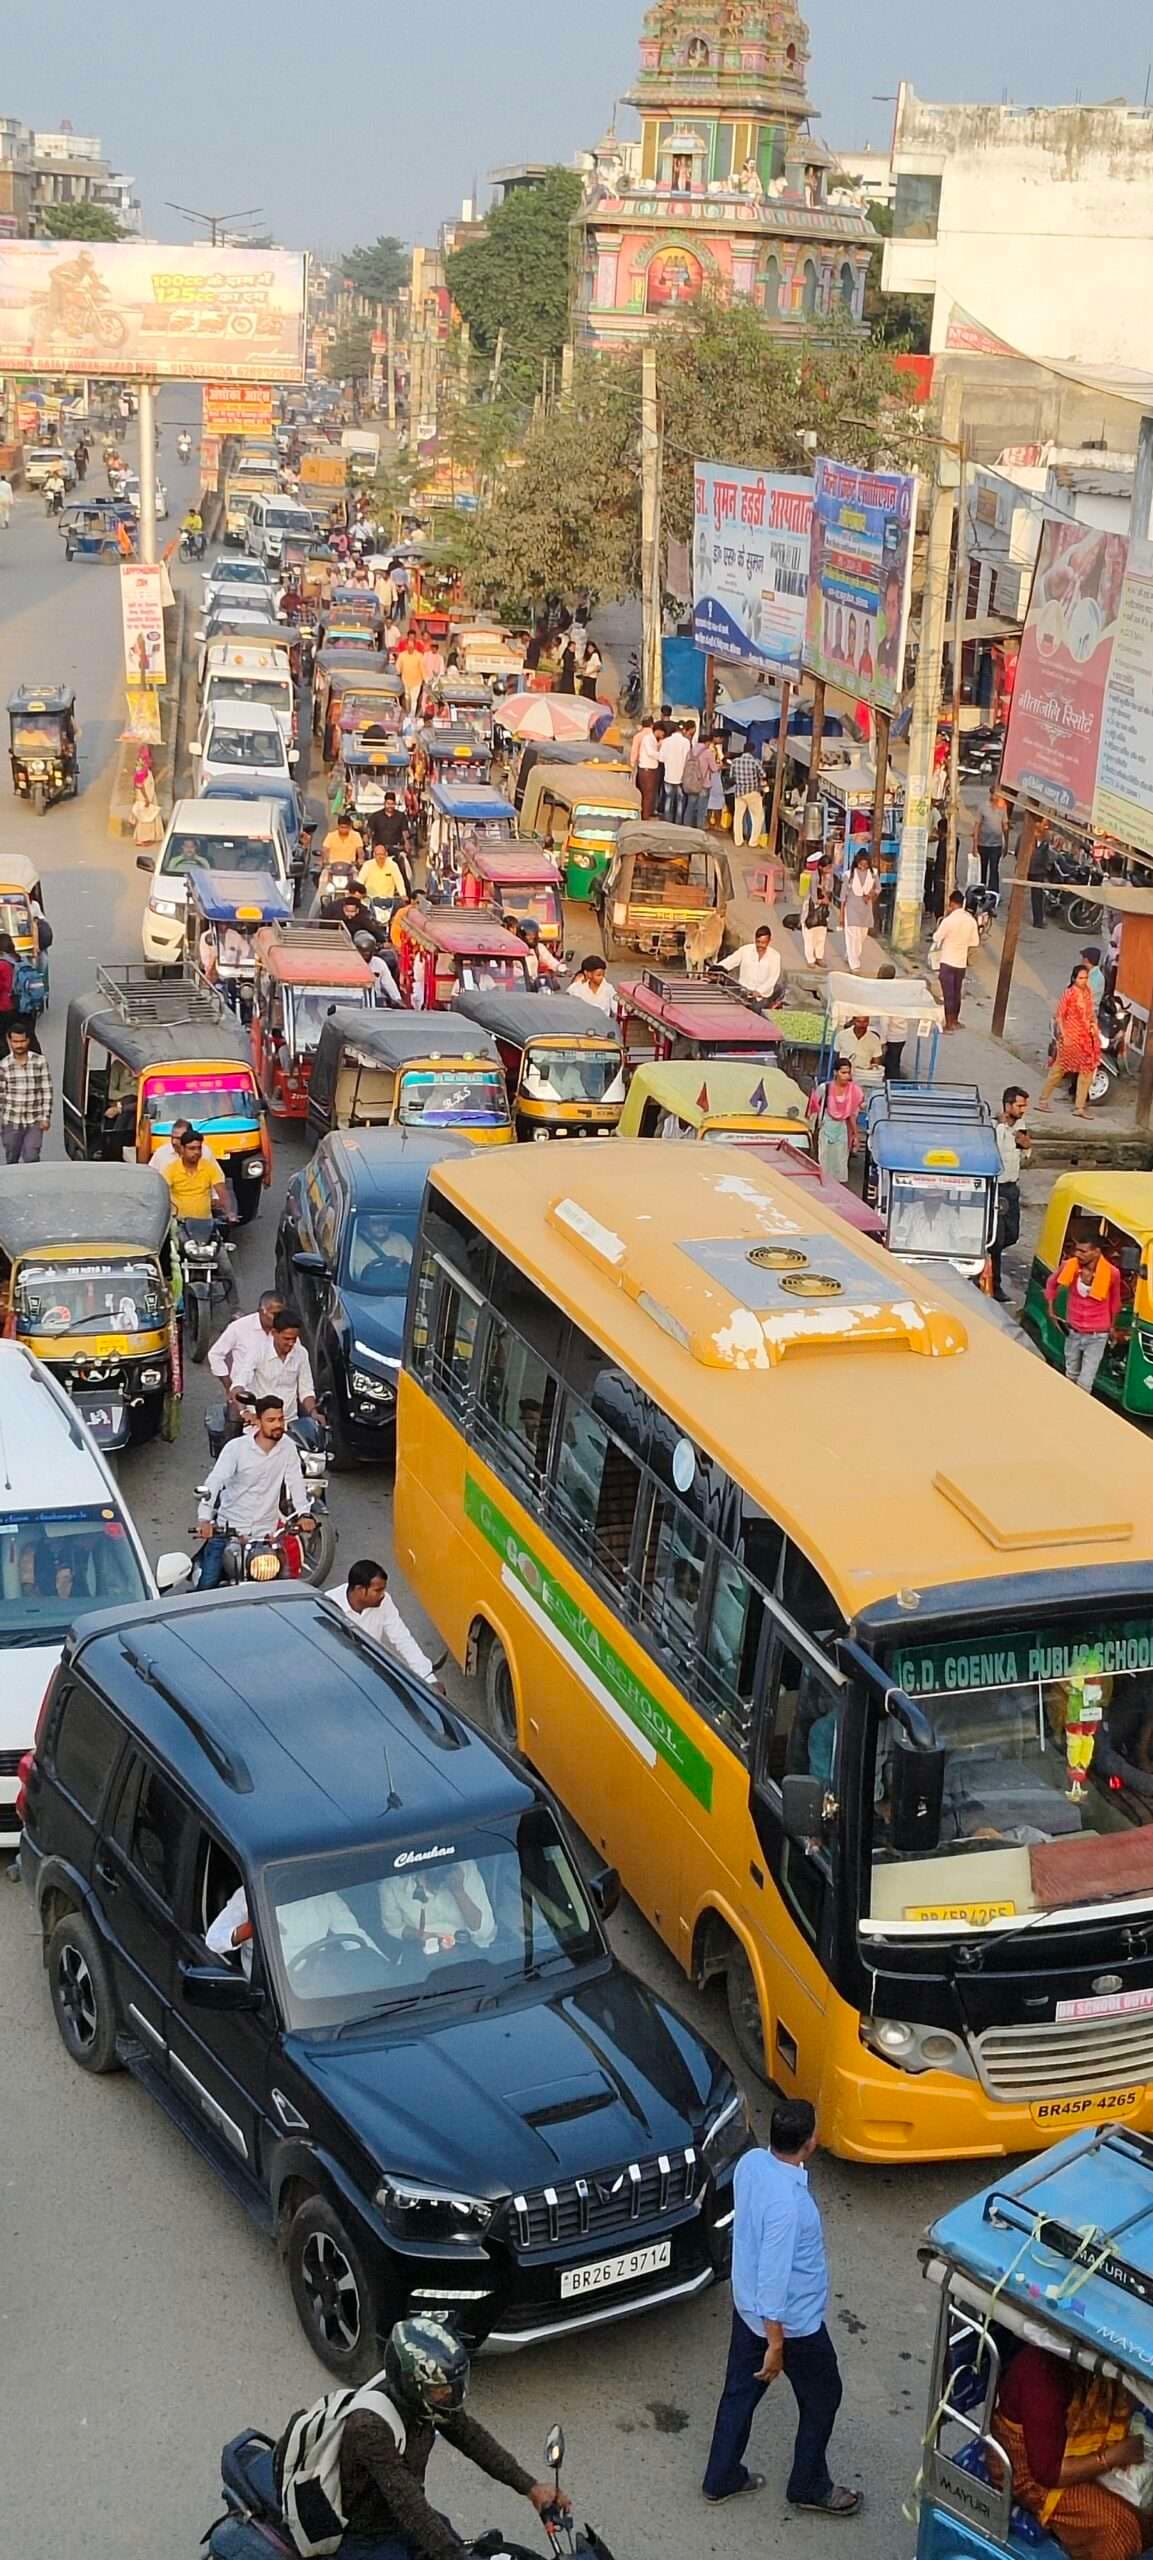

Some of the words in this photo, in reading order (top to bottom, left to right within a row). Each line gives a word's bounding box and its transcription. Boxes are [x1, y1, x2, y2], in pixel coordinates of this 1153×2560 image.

[152, 274, 206, 289] 100cc
[154, 288, 218, 305] 125cc
[902, 1659, 940, 1693] G.D.
[944, 1651, 1018, 1688] GOENKA
[1028, 1644, 1089, 1680] PUBLIC
[1094, 1637, 1153, 1673] SCHOO
[393, 1845, 456, 1868] Chauhan
[1076, 1997, 1121, 2016] SCHOOL
[1038, 2099, 1092, 2118] BR45P
[1096, 2092, 1137, 2108] 4265
[572, 2265, 611, 2290] BR26
[617, 2260, 625, 2277] Z
[630, 2244, 667, 2272] 9714
[1097, 2325, 1153, 2365] MAYU
[940, 2476, 990, 2519] MAYURI
